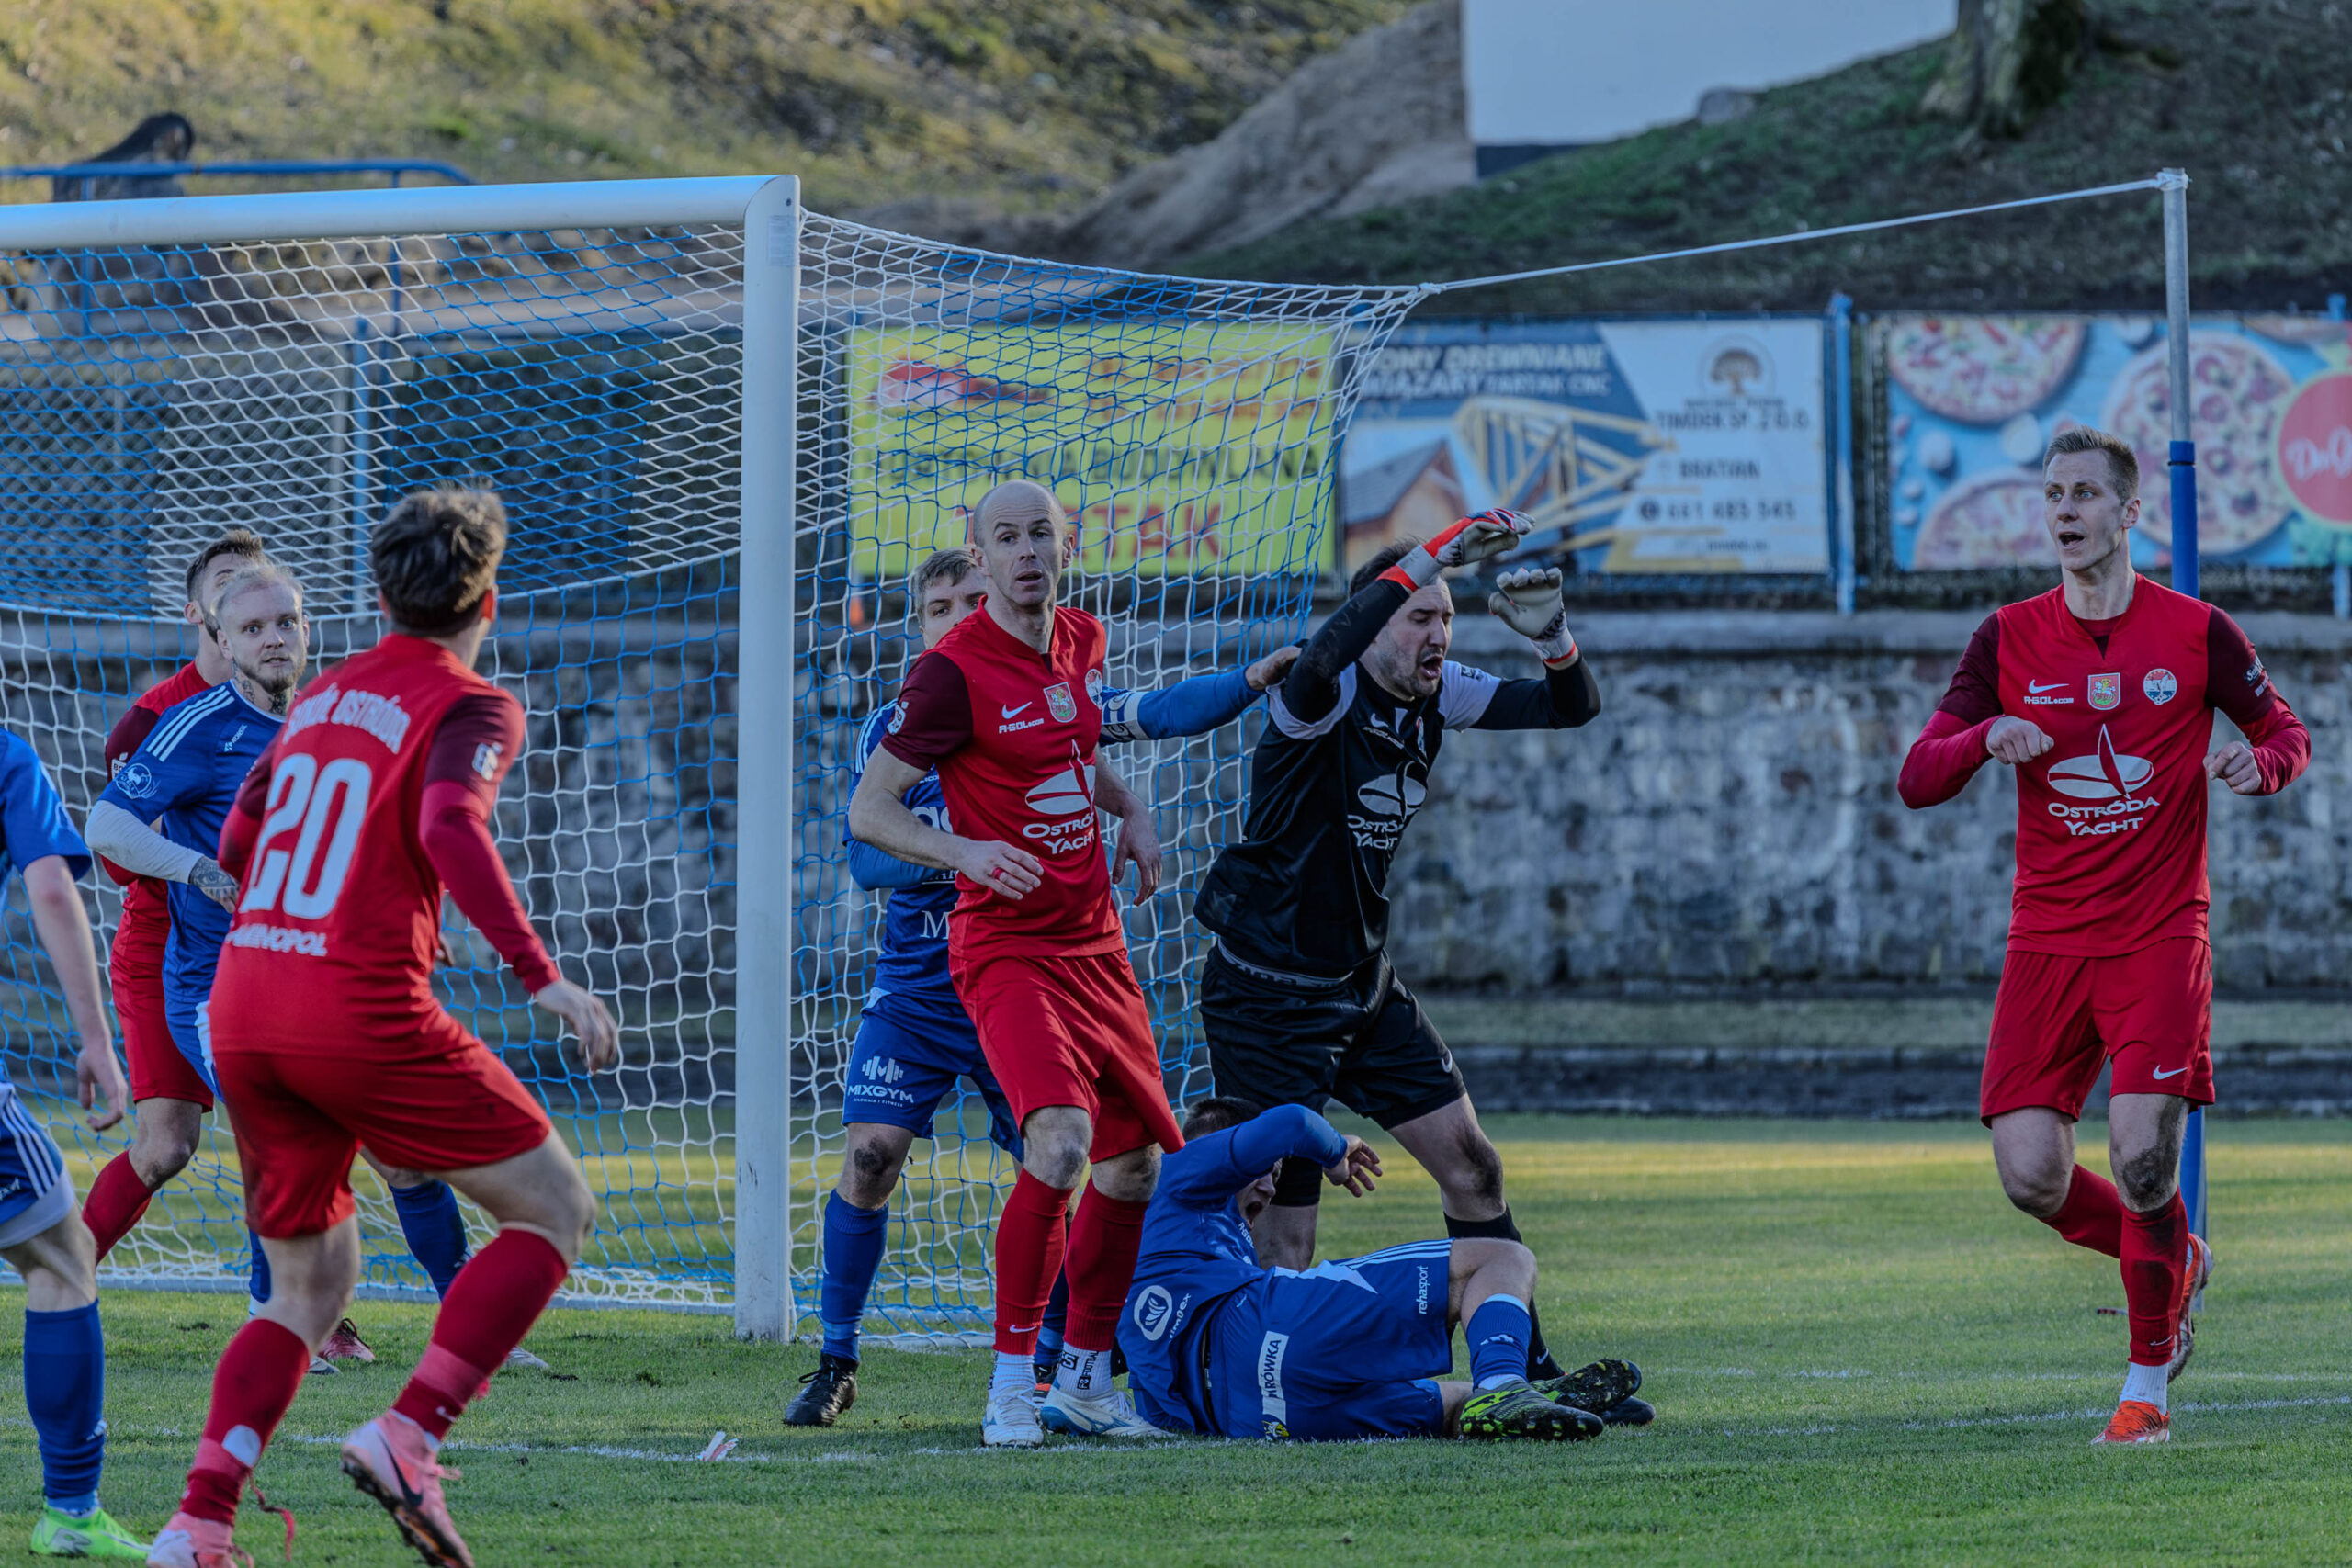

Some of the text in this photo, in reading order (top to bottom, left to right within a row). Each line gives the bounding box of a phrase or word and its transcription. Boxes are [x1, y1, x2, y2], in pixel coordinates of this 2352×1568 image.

[2047, 795, 2161, 818] OSTRÓDA
[238, 751, 373, 920] 20
[2064, 817, 2143, 837] YACHT
[847, 1084, 915, 1104] MIXGYM
[1415, 1265, 1431, 1315] rehasport
